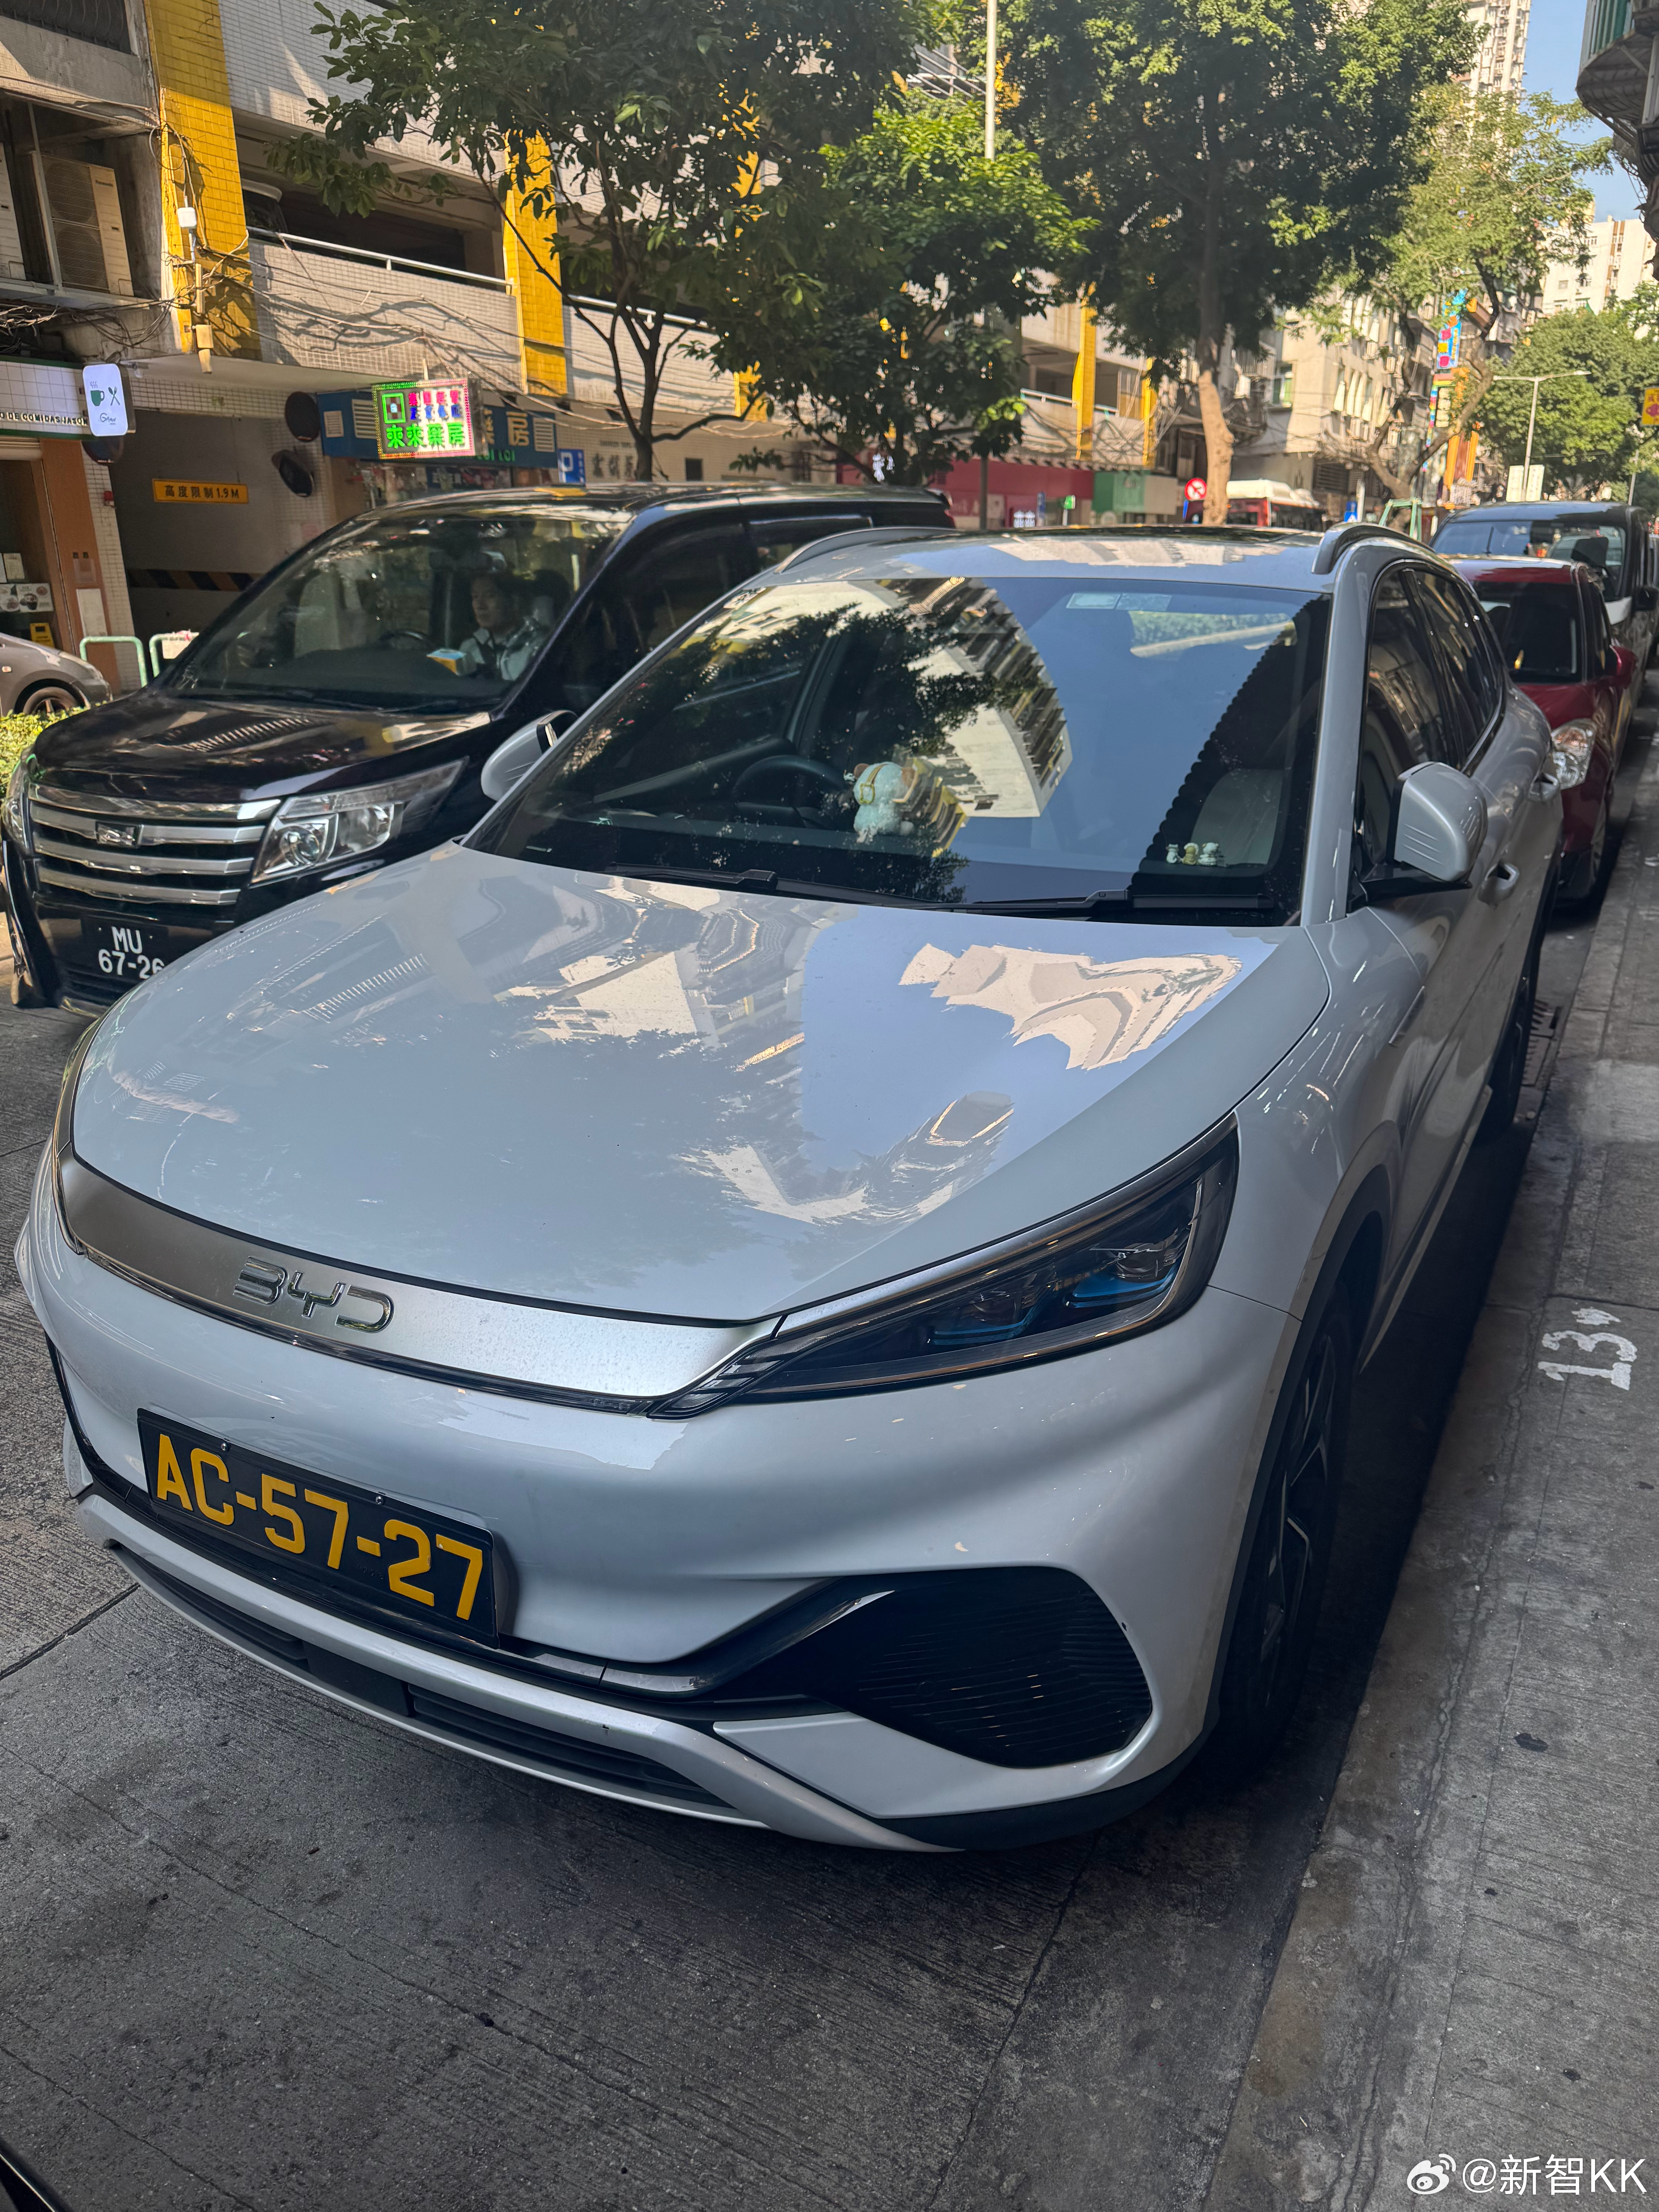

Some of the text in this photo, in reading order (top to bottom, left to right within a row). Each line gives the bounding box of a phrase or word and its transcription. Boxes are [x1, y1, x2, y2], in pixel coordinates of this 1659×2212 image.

[6, 412, 19, 421] DE
[21, 413, 60, 424] COMIDAS
[560, 452, 574, 483] P
[111, 926, 143, 954] MU
[233, 1256, 394, 1333] BYD
[156, 1434, 483, 1621] AC-57-27
